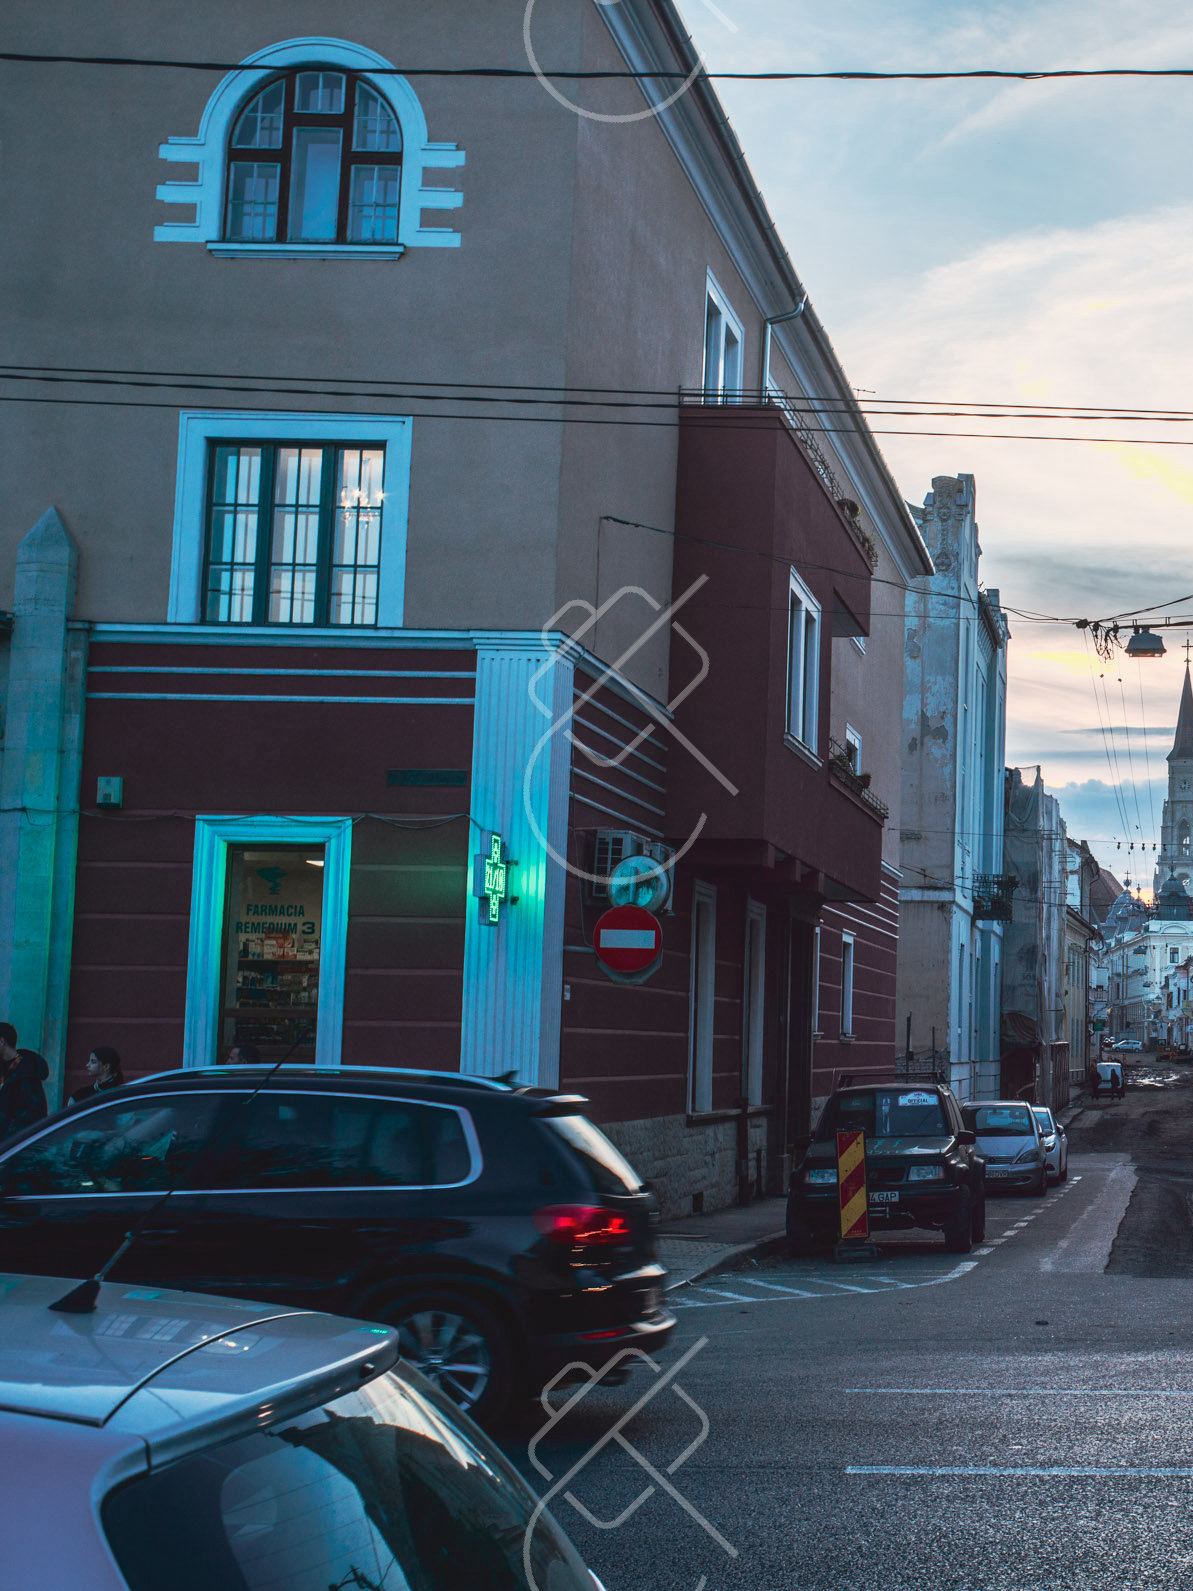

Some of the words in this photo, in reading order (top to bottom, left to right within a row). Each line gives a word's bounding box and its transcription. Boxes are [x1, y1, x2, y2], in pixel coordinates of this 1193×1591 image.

[246, 904, 305, 917] FARMACIA
[235, 922, 297, 935] REMEDIUM
[301, 921, 316, 935] 3
[878, 1192, 897, 1202] GAP
